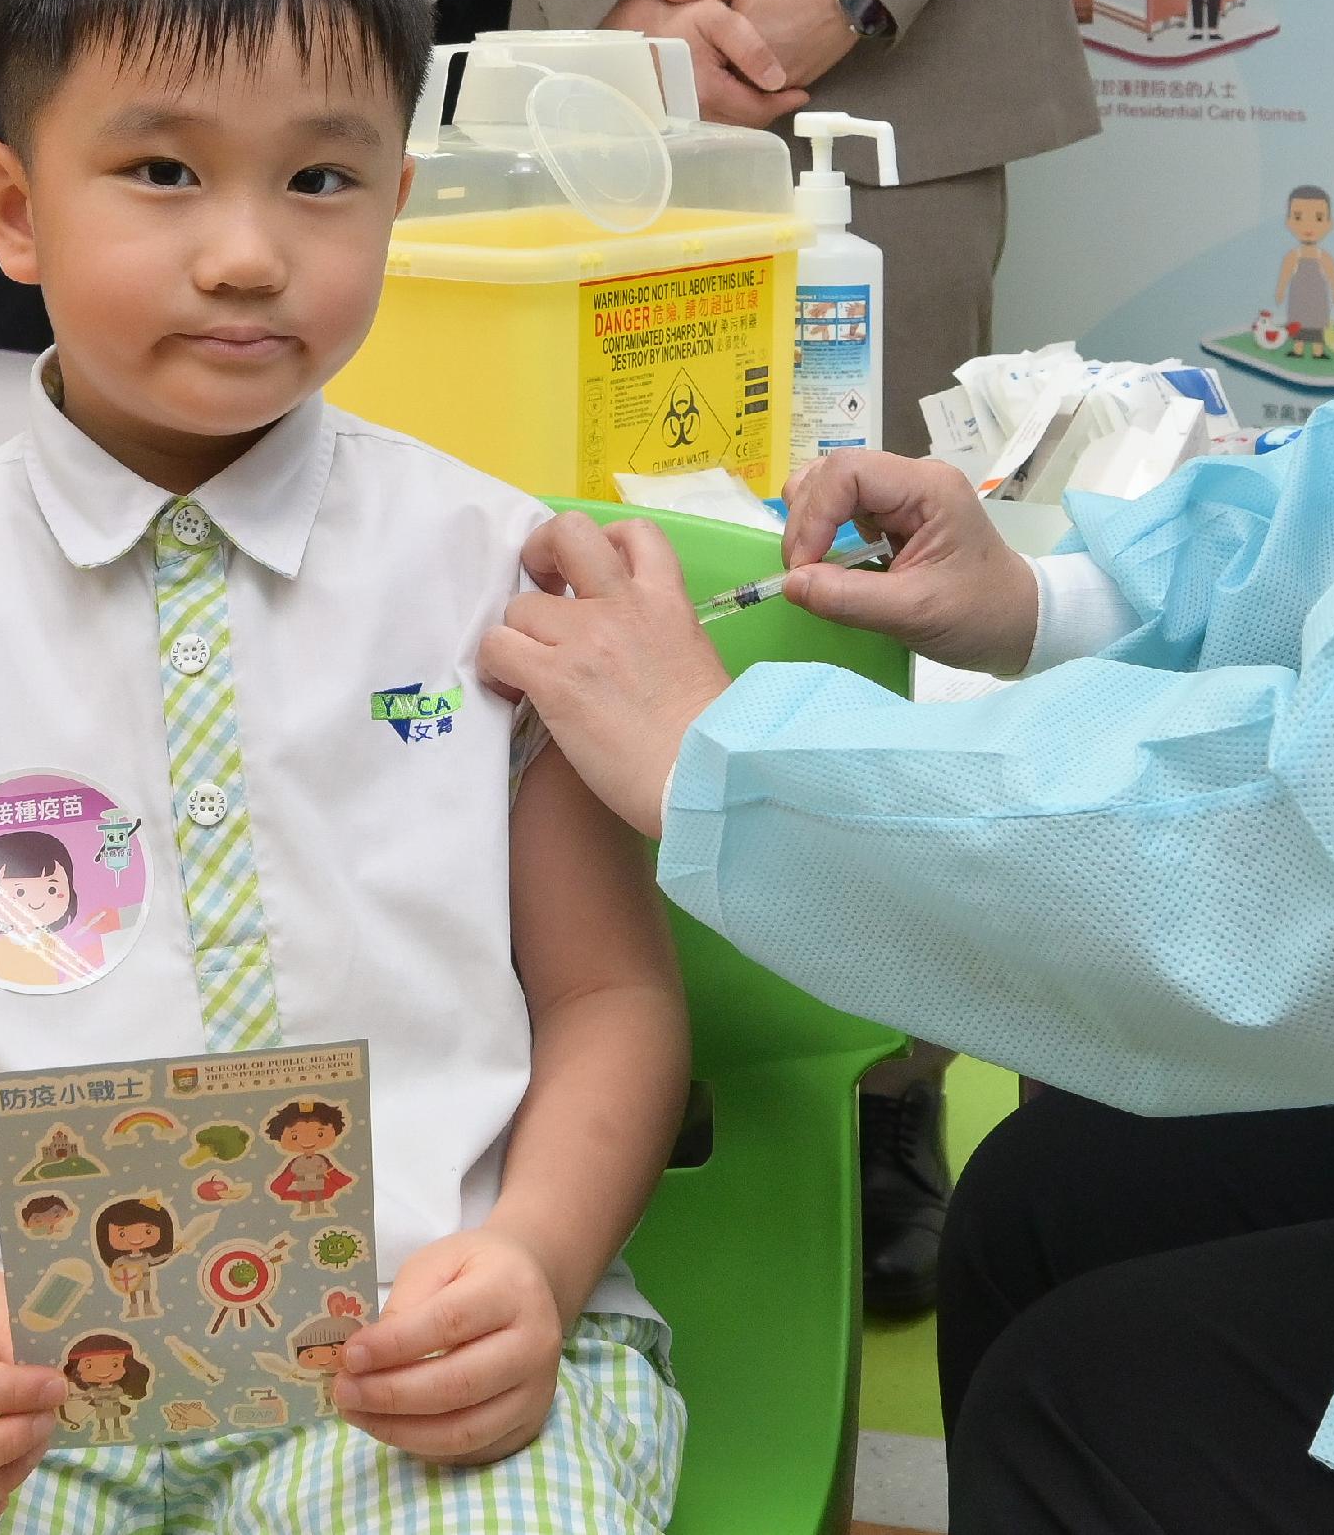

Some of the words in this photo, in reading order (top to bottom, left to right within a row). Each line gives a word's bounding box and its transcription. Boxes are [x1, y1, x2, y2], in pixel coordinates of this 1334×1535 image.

[1118, 103, 1203, 121] Residential
[1207, 104, 1246, 122] Care
[1250, 106, 1307, 123] Homes
[651, 283, 669, 301] NOT
[670, 280, 687, 298] FILL
[689, 275, 716, 295] ABOVE
[717, 272, 736, 290] THIS
[737, 270, 755, 287] LINE
[594, 306, 651, 338] DANGER
[602, 328, 664, 355] CONTAMINATED
[665, 324, 697, 342] SHARPS
[697, 319, 717, 338] ONLY
[611, 349, 649, 373] DESTROY
[649, 346, 661, 365] BY
[661, 339, 714, 363] INCINERATION
[686, 450, 710, 466] WASTE
[381, 694, 452, 718] YWCA
[204, 1063, 250, 1074] SCHOOL
[250, 1061, 264, 1069] OF
[268, 1056, 309, 1068] PUBLIC
[310, 1052, 354, 1063] HEALTH
[226, 1068, 281, 1079] UNIVERSITY
[283, 1065, 295, 1074] OF
[296, 1063, 325, 1073] HONG
[326, 1060, 354, 1070] KONG
[0, 1077, 144, 1112] 防疫小戰士
